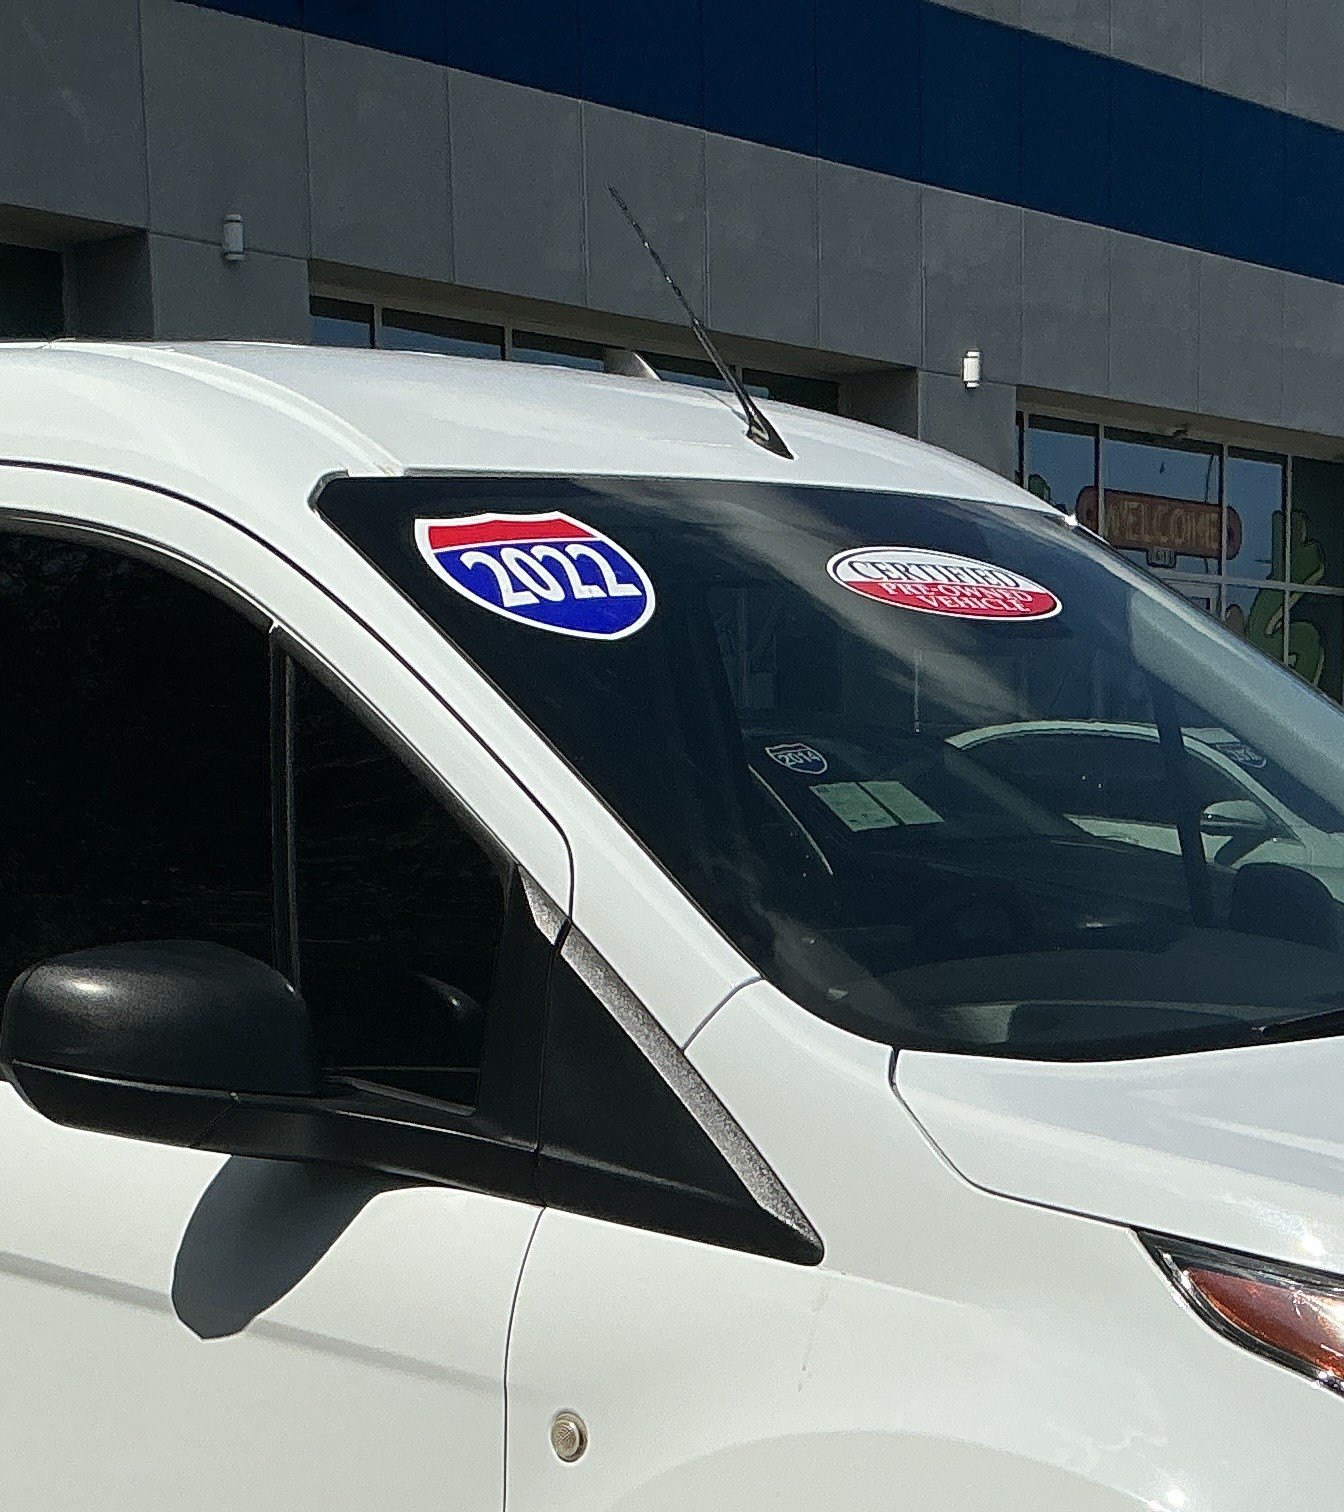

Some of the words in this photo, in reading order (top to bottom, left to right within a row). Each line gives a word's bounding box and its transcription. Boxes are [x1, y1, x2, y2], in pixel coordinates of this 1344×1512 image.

[460, 544, 642, 607] 2022
[849, 561, 1019, 588] CERTIFIED
[878, 582, 1033, 602] PRE-OWNED
[916, 595, 1030, 613] VEHICLE
